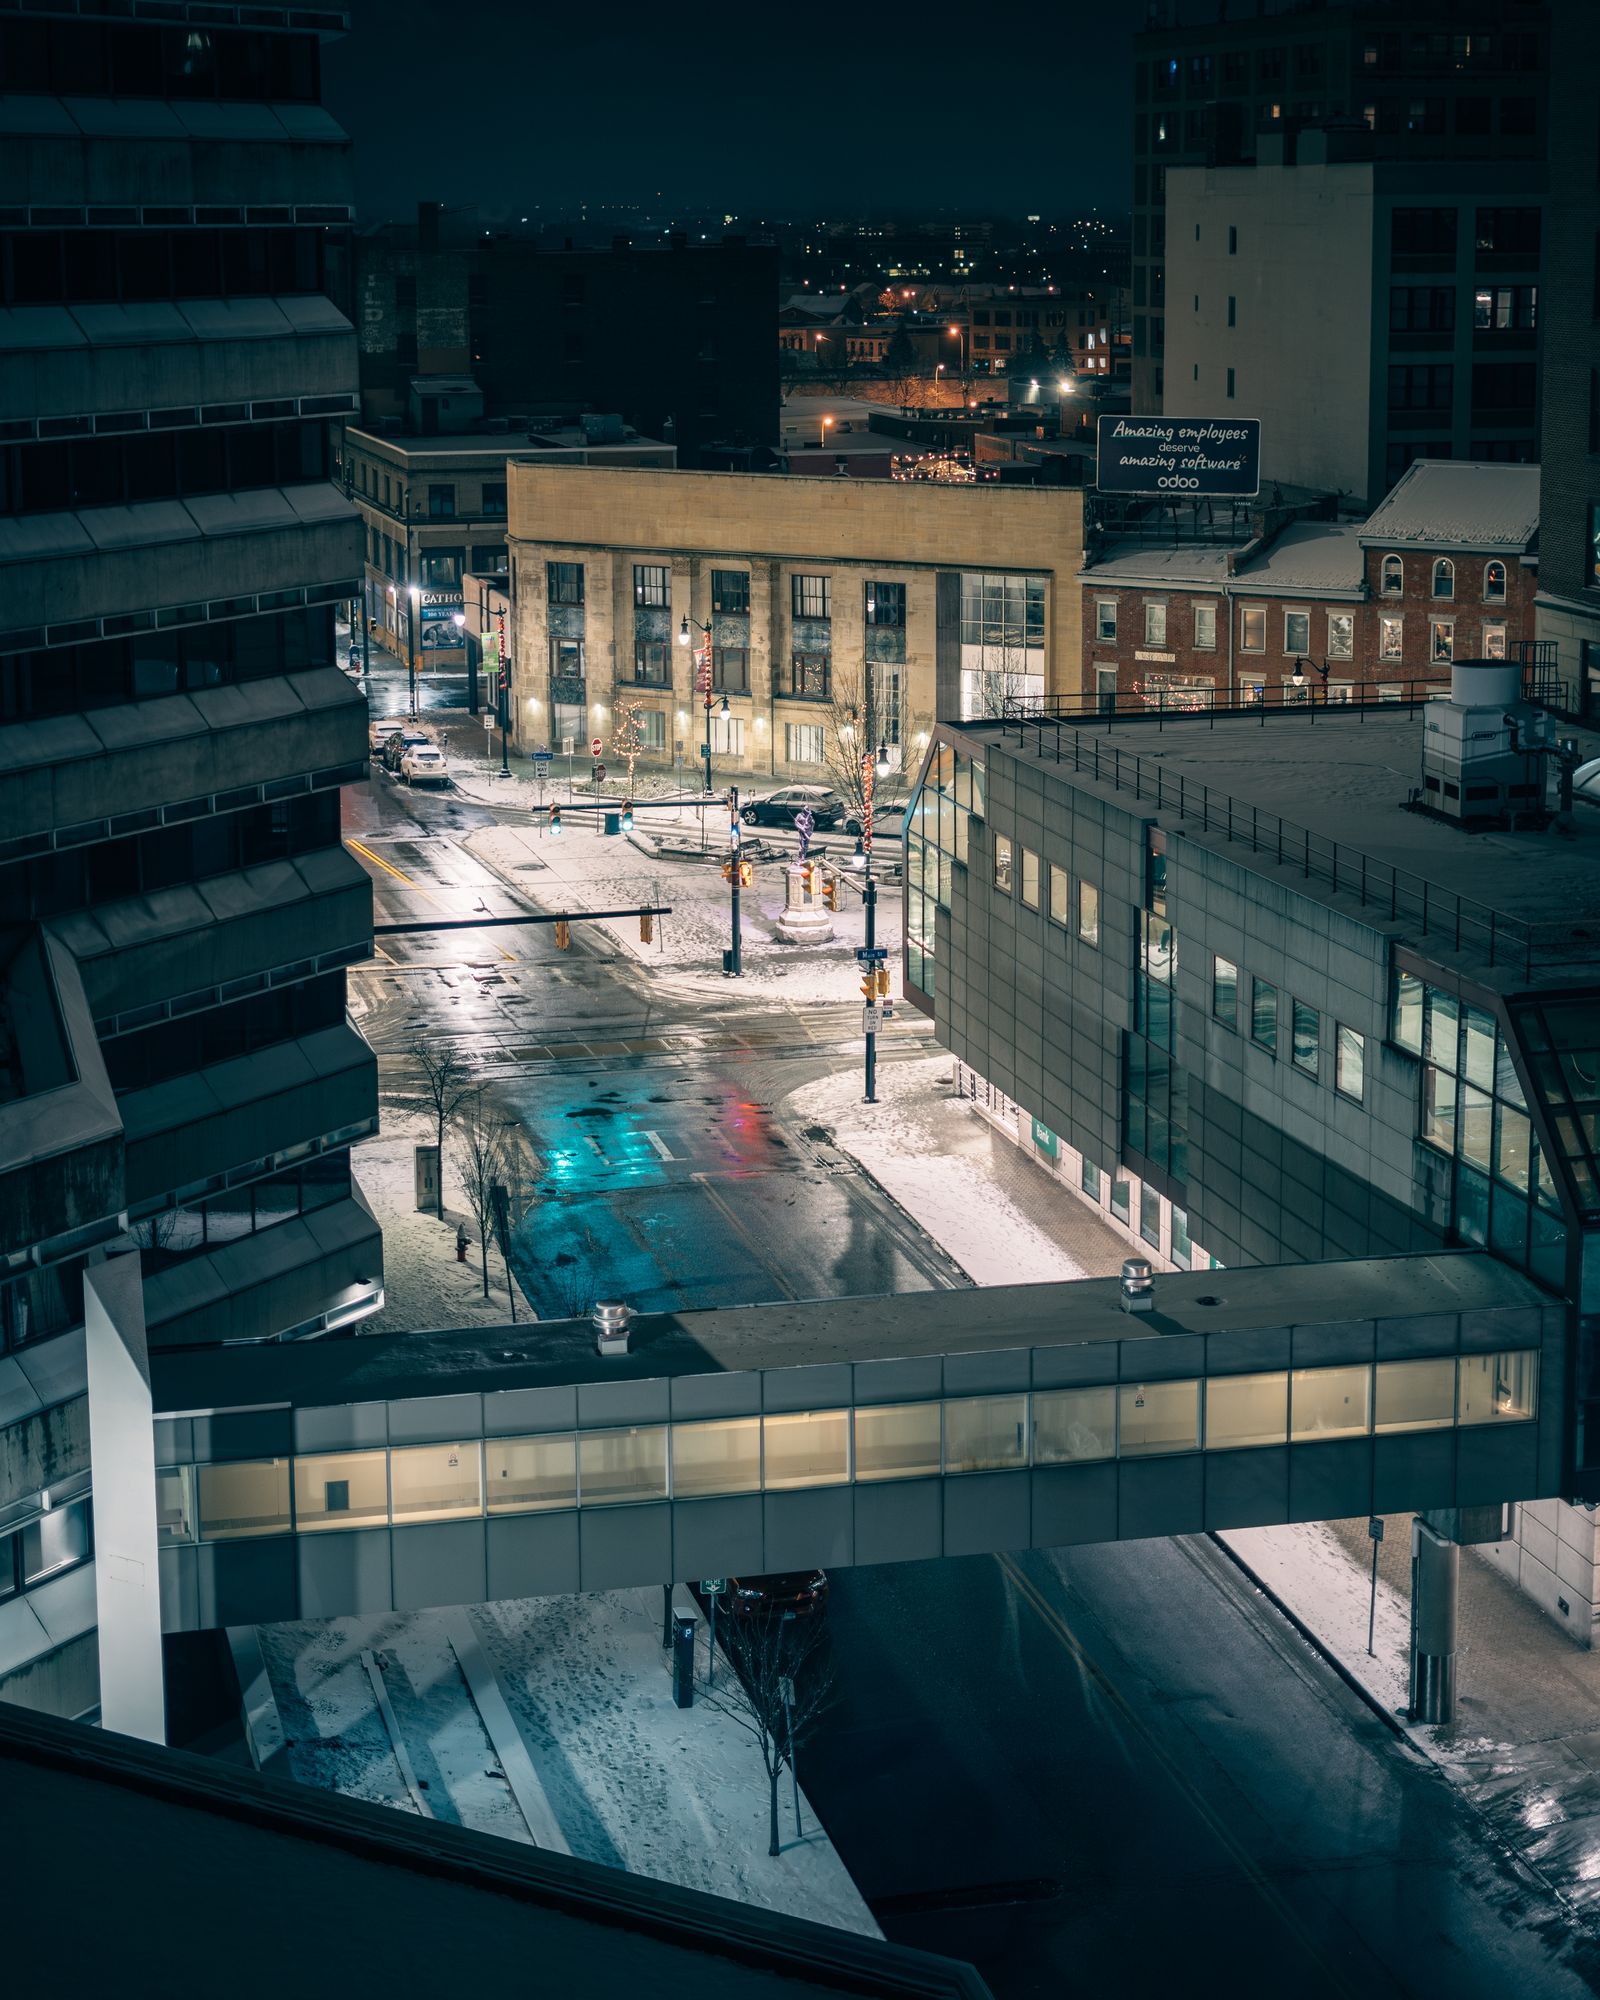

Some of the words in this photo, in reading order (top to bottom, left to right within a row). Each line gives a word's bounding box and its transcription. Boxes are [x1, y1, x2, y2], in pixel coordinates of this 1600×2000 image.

[1112, 420, 1174, 441] Amazing
[1178, 423, 1249, 444] employees
[1158, 442, 1200, 453] deserve
[1119, 454, 1176, 471] amazing
[1180, 453, 1241, 470] software
[1157, 474, 1200, 489] odoo
[1036, 1124, 1049, 1145] Bank
